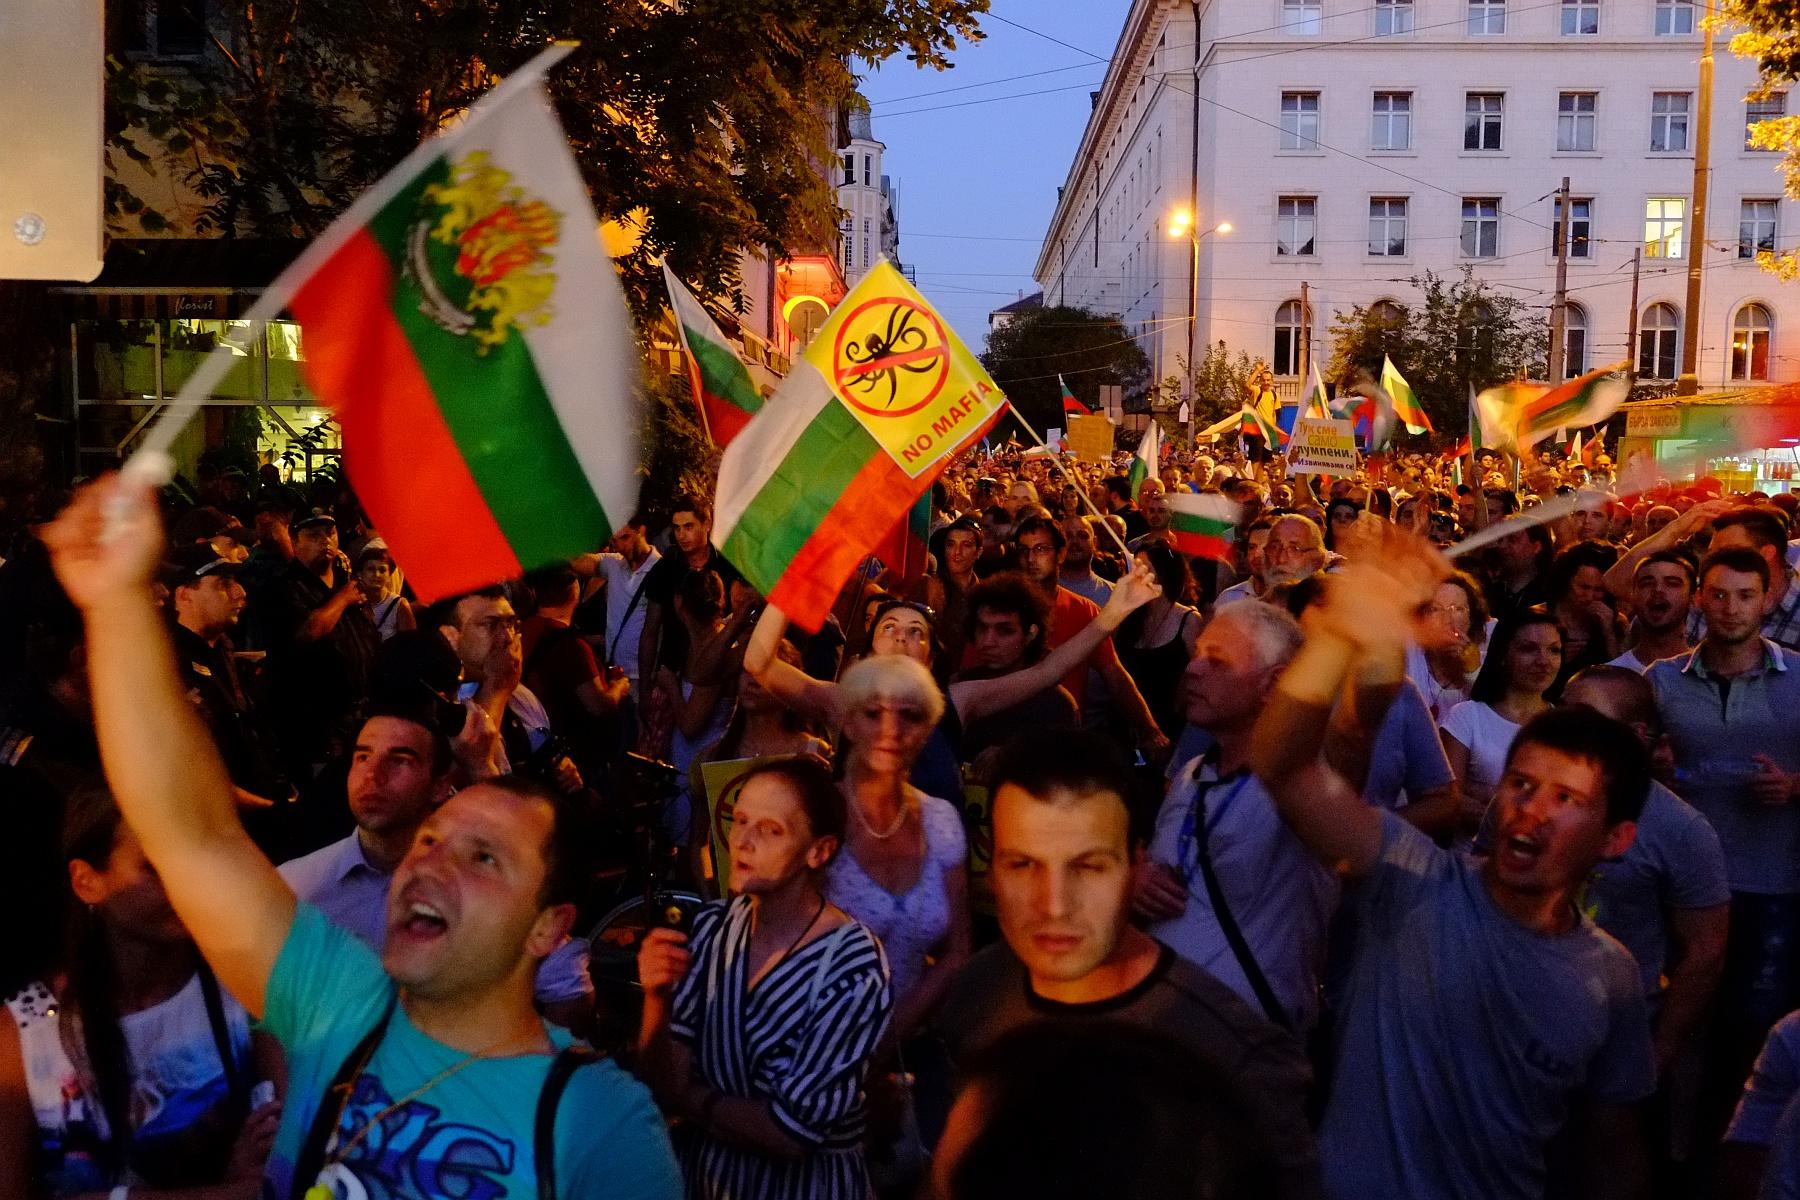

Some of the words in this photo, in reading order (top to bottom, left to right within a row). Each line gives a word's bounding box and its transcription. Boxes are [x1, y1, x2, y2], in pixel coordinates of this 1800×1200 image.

[175, 296, 213, 315] florist
[902, 434, 933, 463] NO
[932, 381, 993, 438] MAFIA
[1300, 421, 1315, 435] Тук
[1317, 425, 1337, 436] сме
[1308, 434, 1338, 447] само
